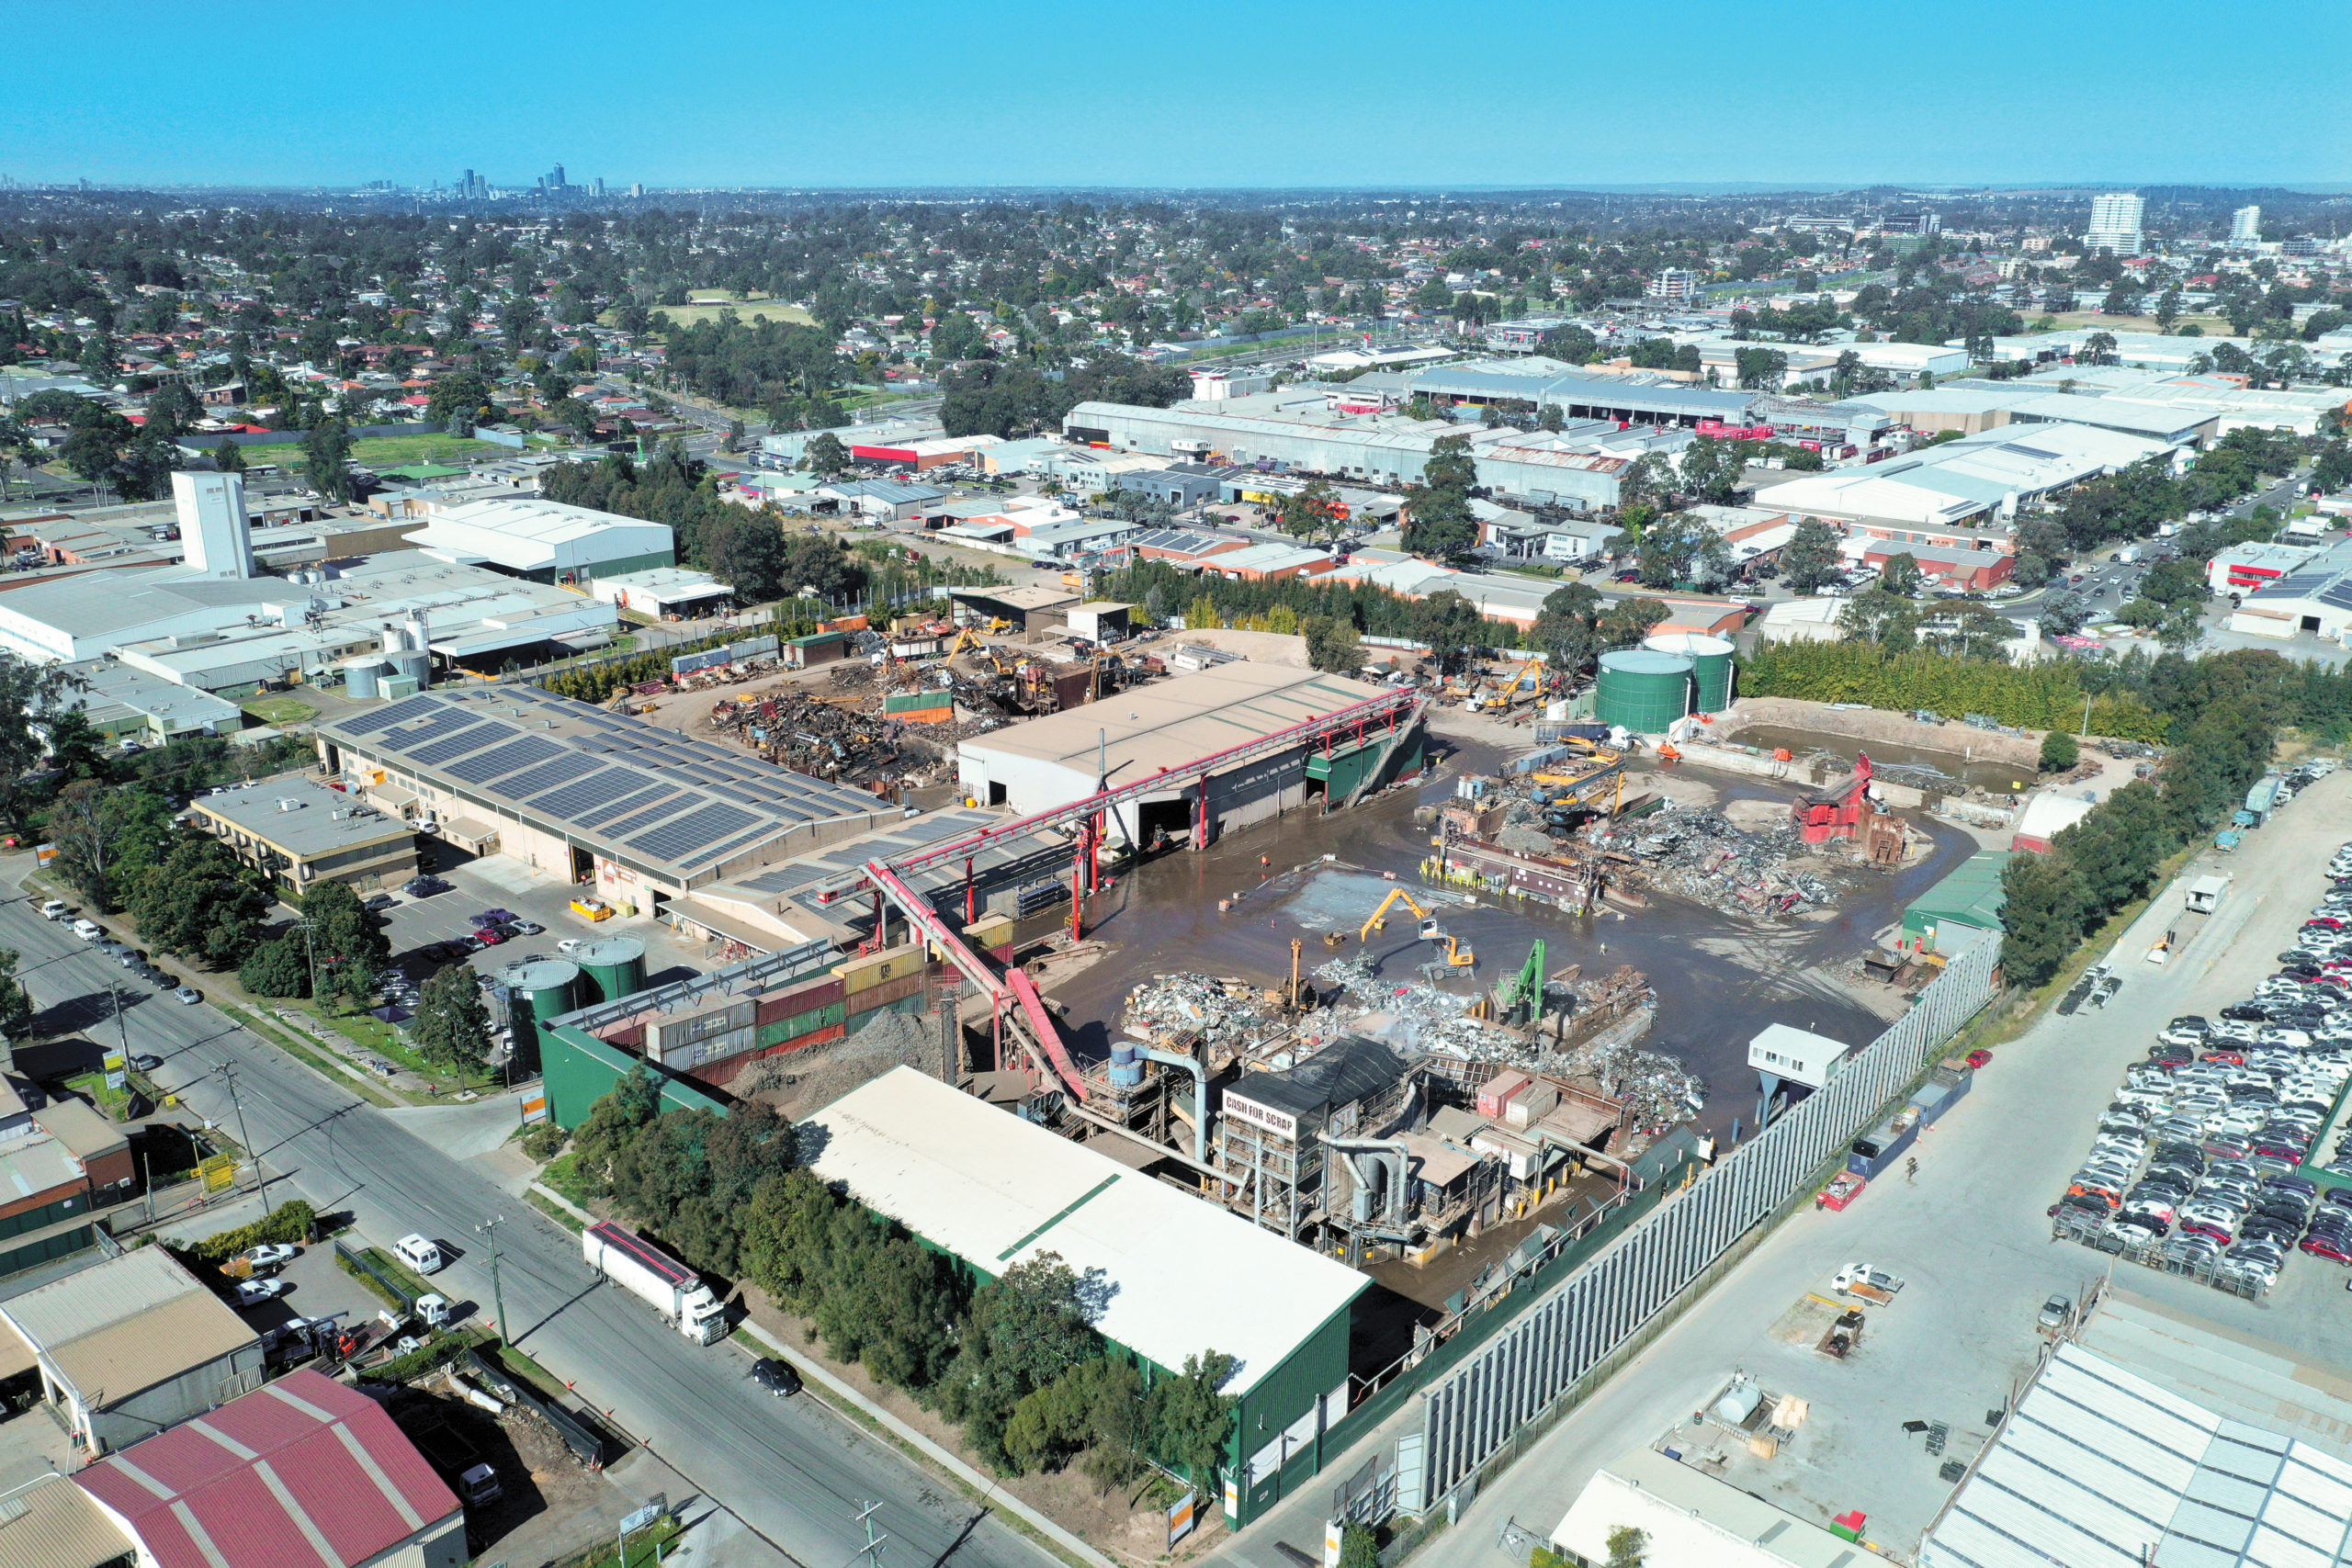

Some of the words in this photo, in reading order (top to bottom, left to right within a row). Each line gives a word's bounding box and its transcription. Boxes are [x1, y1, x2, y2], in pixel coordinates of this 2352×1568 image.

[1227, 1097, 1247, 1114] CASH
[1249, 1105, 1263, 1121] FOR
[1265, 1111, 1293, 1132] SCRAP
